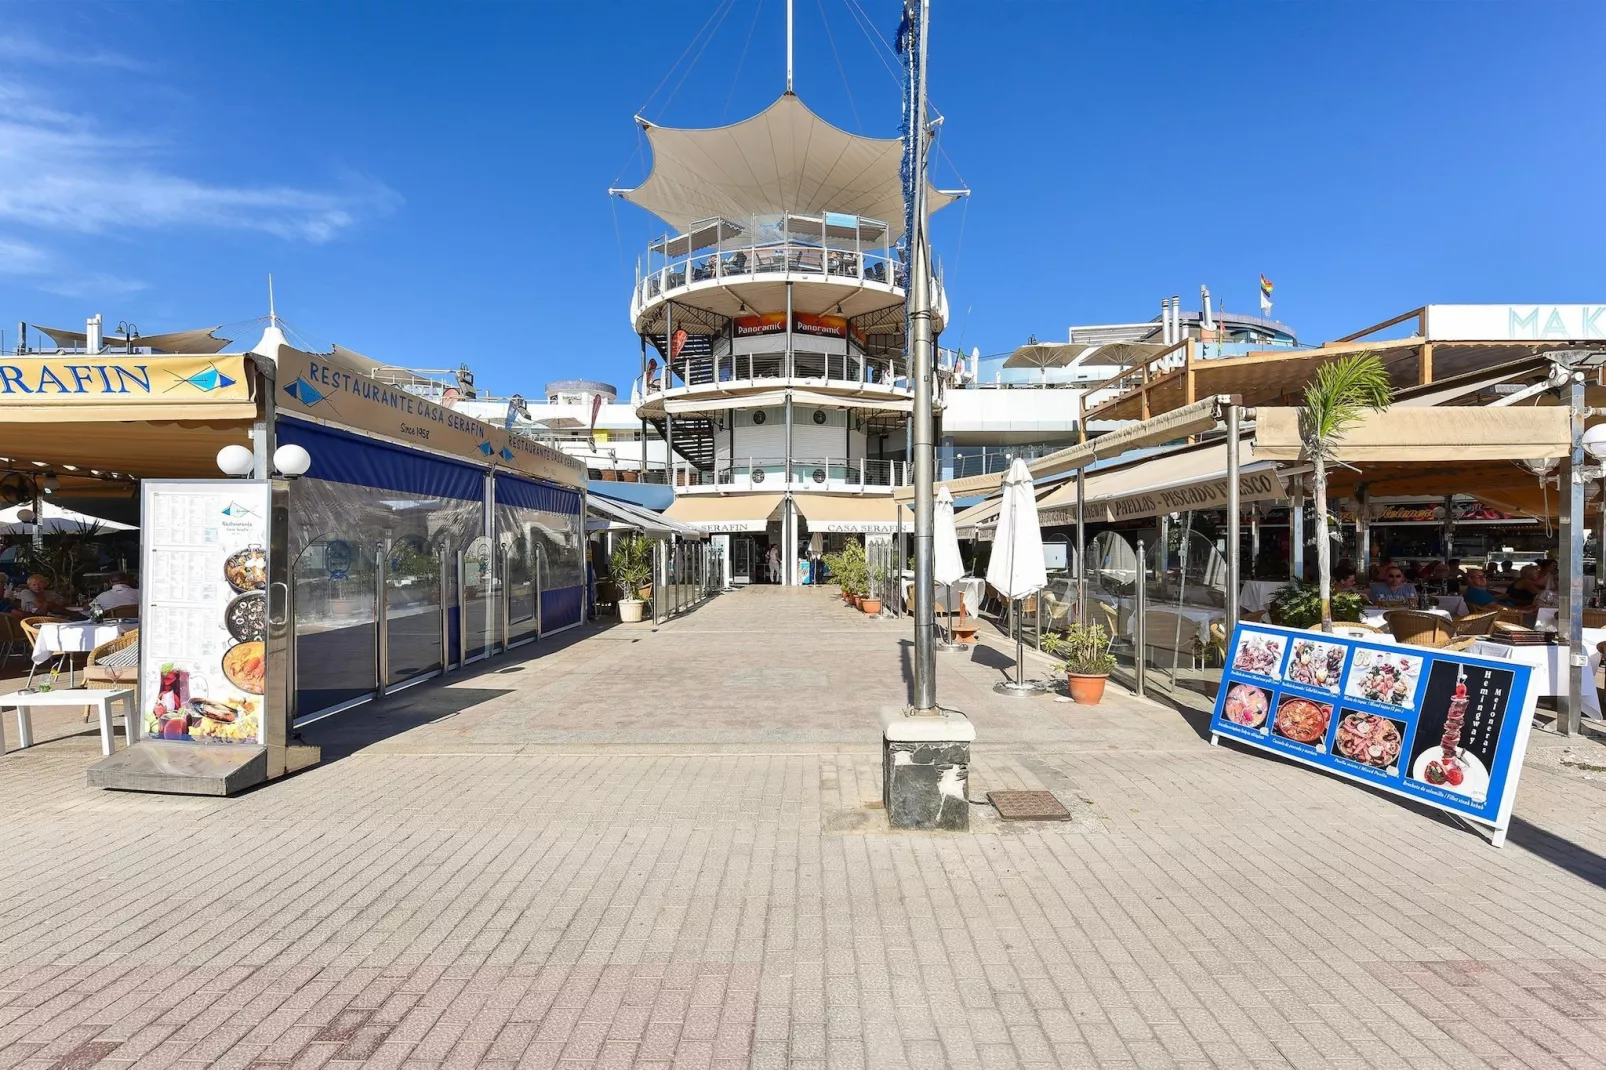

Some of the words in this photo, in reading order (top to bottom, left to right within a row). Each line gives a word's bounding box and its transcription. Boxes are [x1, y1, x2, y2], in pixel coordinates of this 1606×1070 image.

[0, 364, 151, 394] RAFIN
[309, 361, 414, 415] RESTAURANTE
[417, 400, 445, 424] CASA
[400, 422, 415, 436] Since
[508, 435, 550, 461] RESTAURANTE
[1115, 496, 1157, 516] PAELLAS
[1162, 484, 1217, 508] PESCADO
[827, 524, 858, 532] CASA
[861, 524, 907, 532] SERAFIN
[1469, 670, 1492, 745] Hemingway
[1481, 688, 1502, 754] Meloneras
